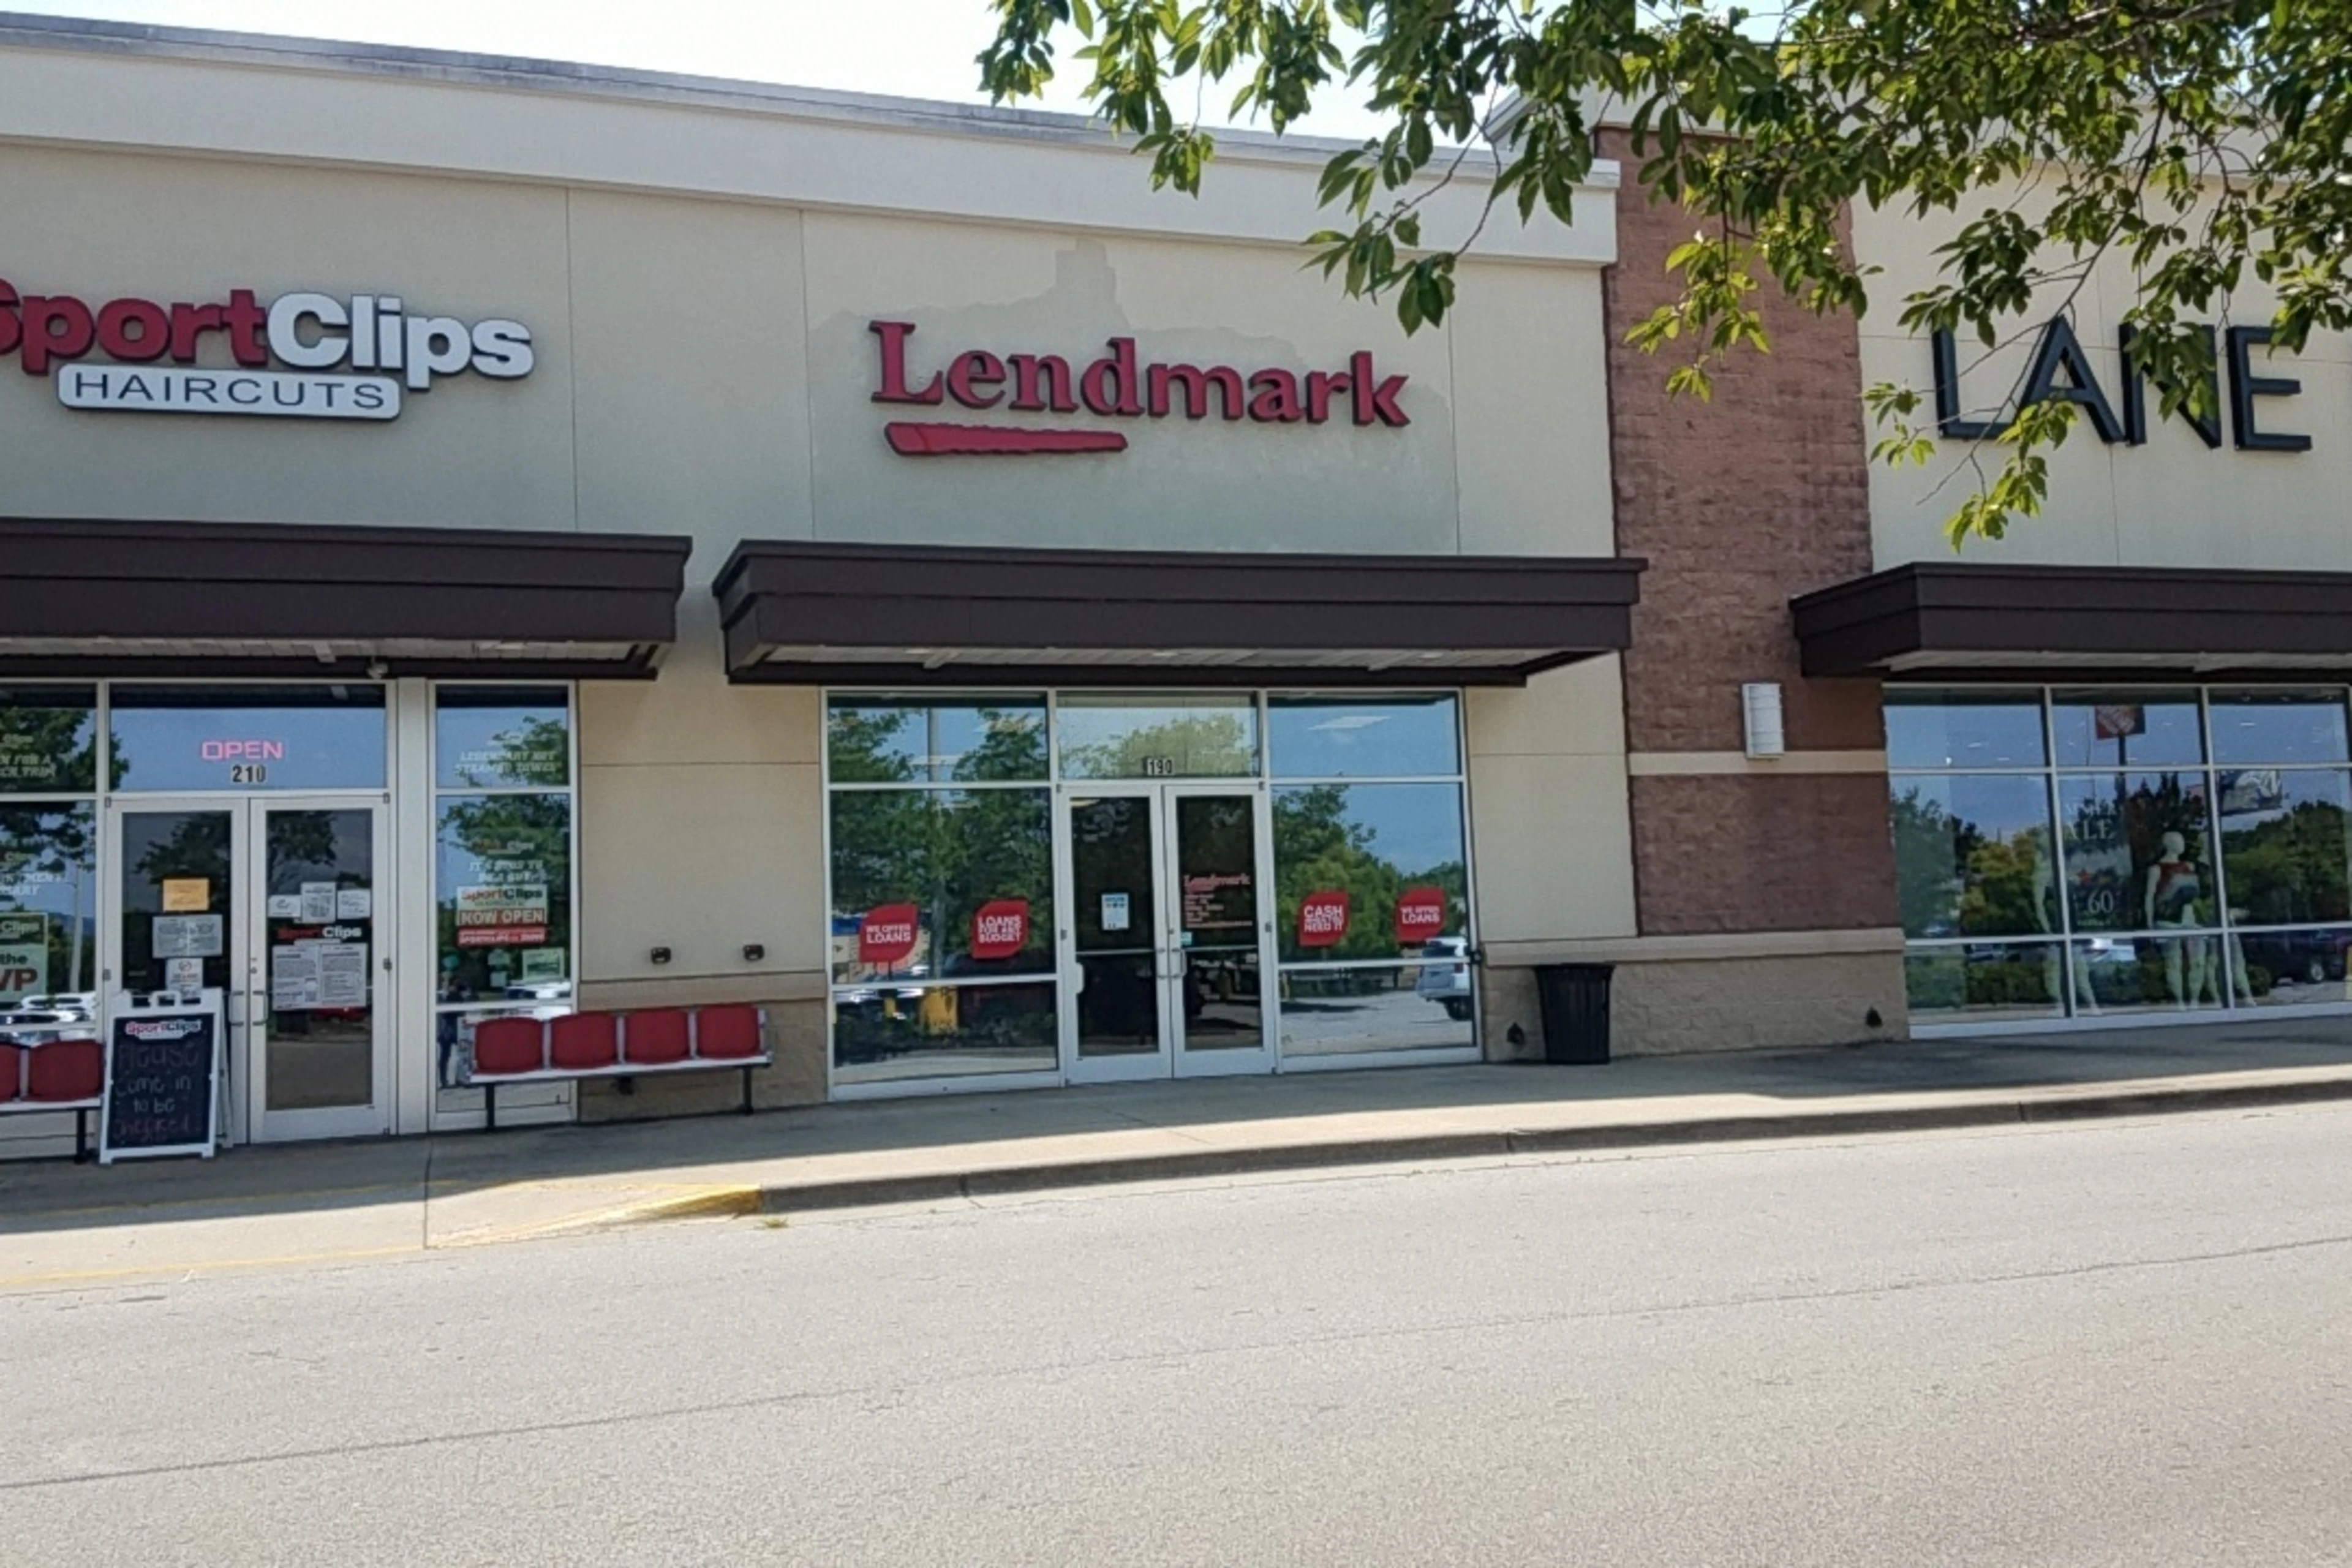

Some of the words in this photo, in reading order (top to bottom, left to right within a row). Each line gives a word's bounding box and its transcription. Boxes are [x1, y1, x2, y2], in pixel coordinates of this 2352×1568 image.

[0, 277, 535, 392] portClips
[868, 320, 1410, 428] Lendmark
[75, 372, 385, 410] HAIRCUTS
[1931, 316, 2313, 452] LANE
[202, 740, 282, 760] OPEN
[232, 764, 266, 783] 210
[1150, 759, 1172, 774] 190
[1303, 905, 1343, 917] CASH
[2087, 890, 2113, 914] 60
[501, 909, 543, 924] OPEN
[978, 915, 1021, 926] LOANS
[866, 932, 911, 944] LOANS
